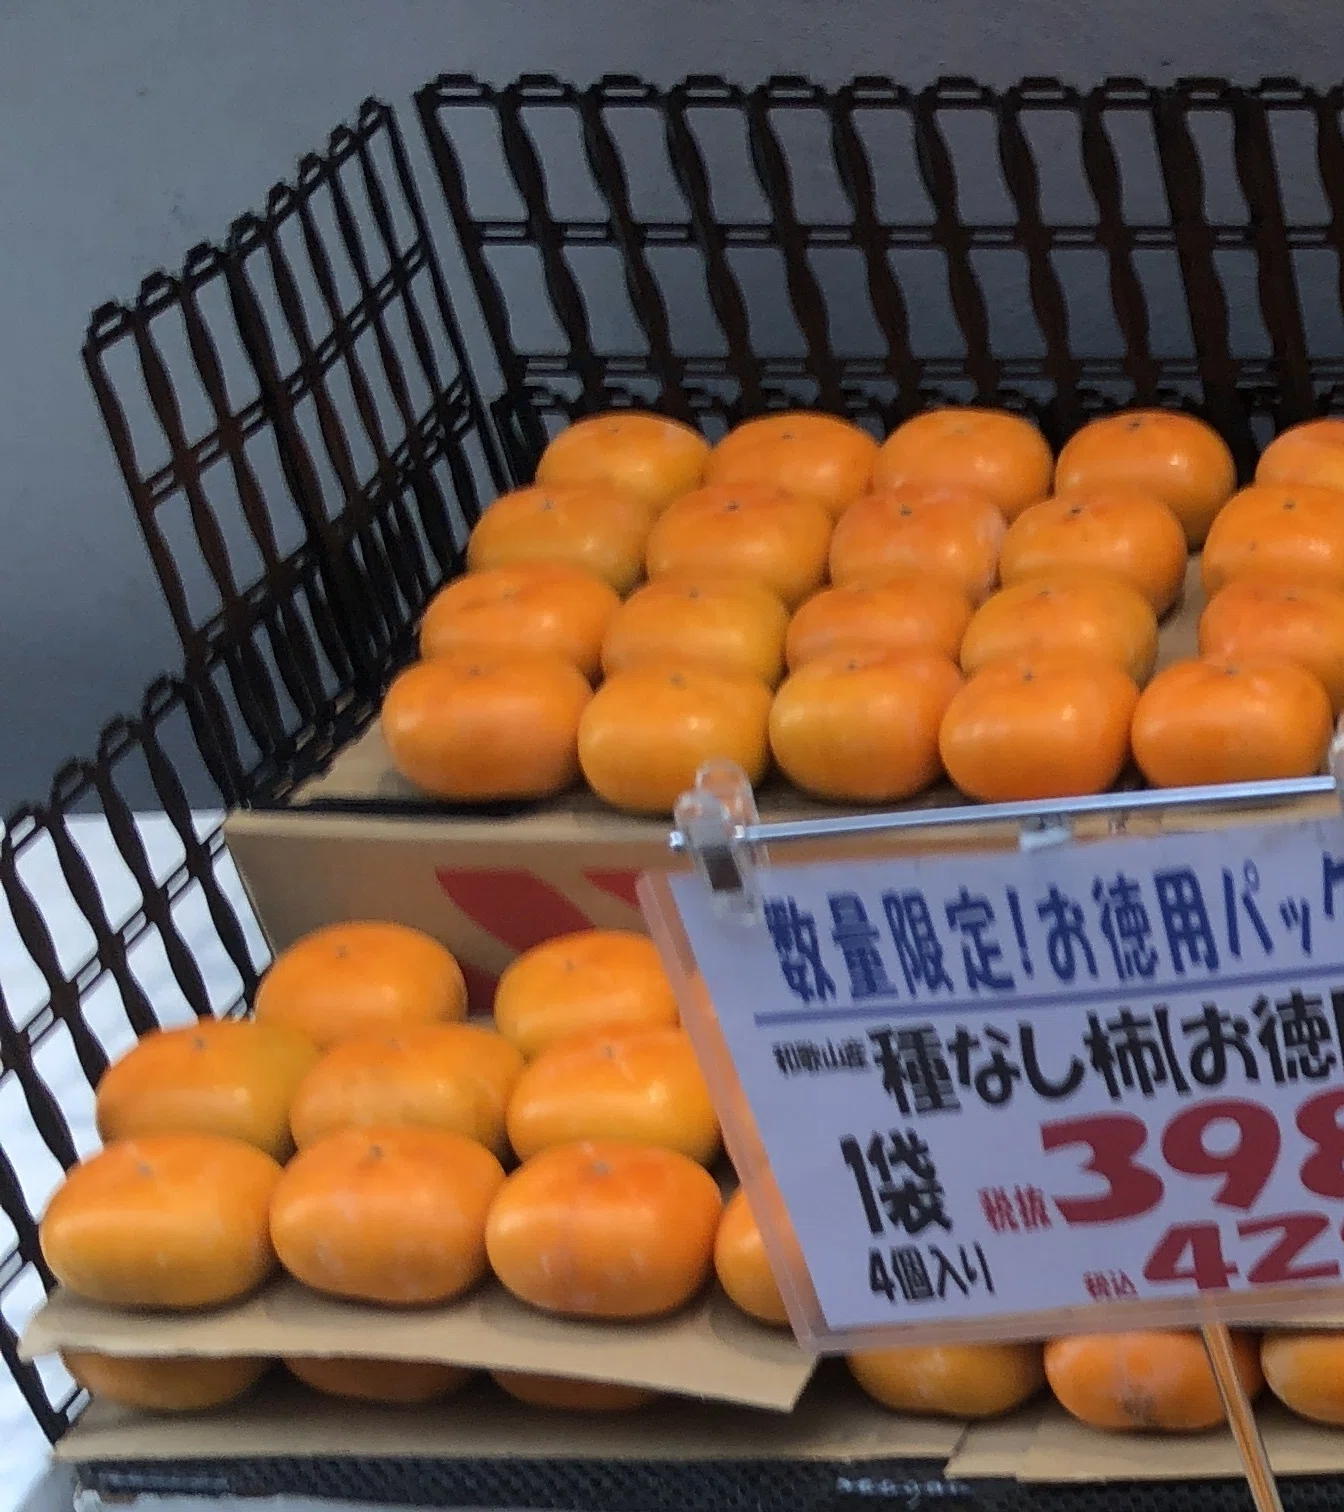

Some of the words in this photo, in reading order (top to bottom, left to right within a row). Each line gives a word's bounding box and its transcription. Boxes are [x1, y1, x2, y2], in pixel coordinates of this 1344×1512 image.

[840, 1126, 952, 1238] 1袋
[868, 1240, 995, 1304] 4個入り
